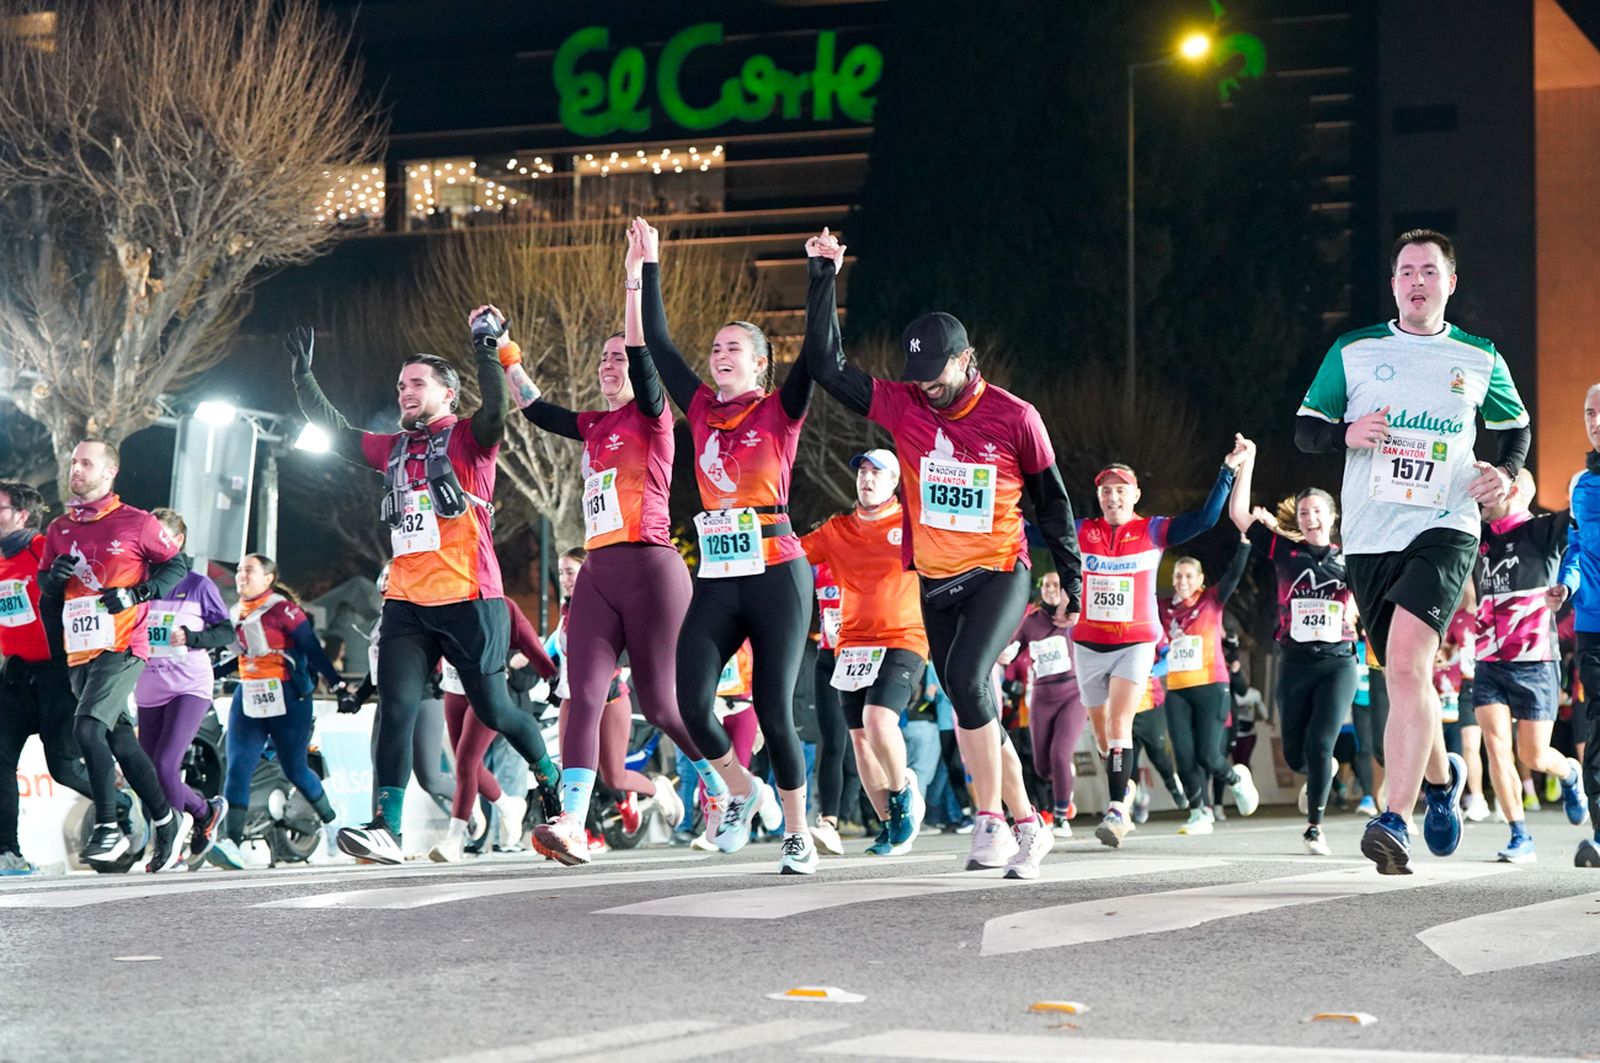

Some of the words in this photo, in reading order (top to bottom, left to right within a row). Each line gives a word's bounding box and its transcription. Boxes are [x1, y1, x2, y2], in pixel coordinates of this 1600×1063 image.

[553, 26, 651, 137] El
[657, 22, 883, 122] Corte
[1382, 446, 1398, 456] SAN
[1391, 438, 1416, 450] NOCHE
[1417, 441, 1427, 450] DE
[936, 467, 957, 477] NOCHE
[957, 469, 967, 478] DE
[1391, 457, 1435, 482] 1577
[928, 474, 942, 483] SAN
[929, 484, 983, 509] 13351
[706, 533, 751, 555] 12613
[1100, 561, 1137, 571] Avanza
[1093, 592, 1125, 606] 2539
[72, 615, 100, 633] 6121
